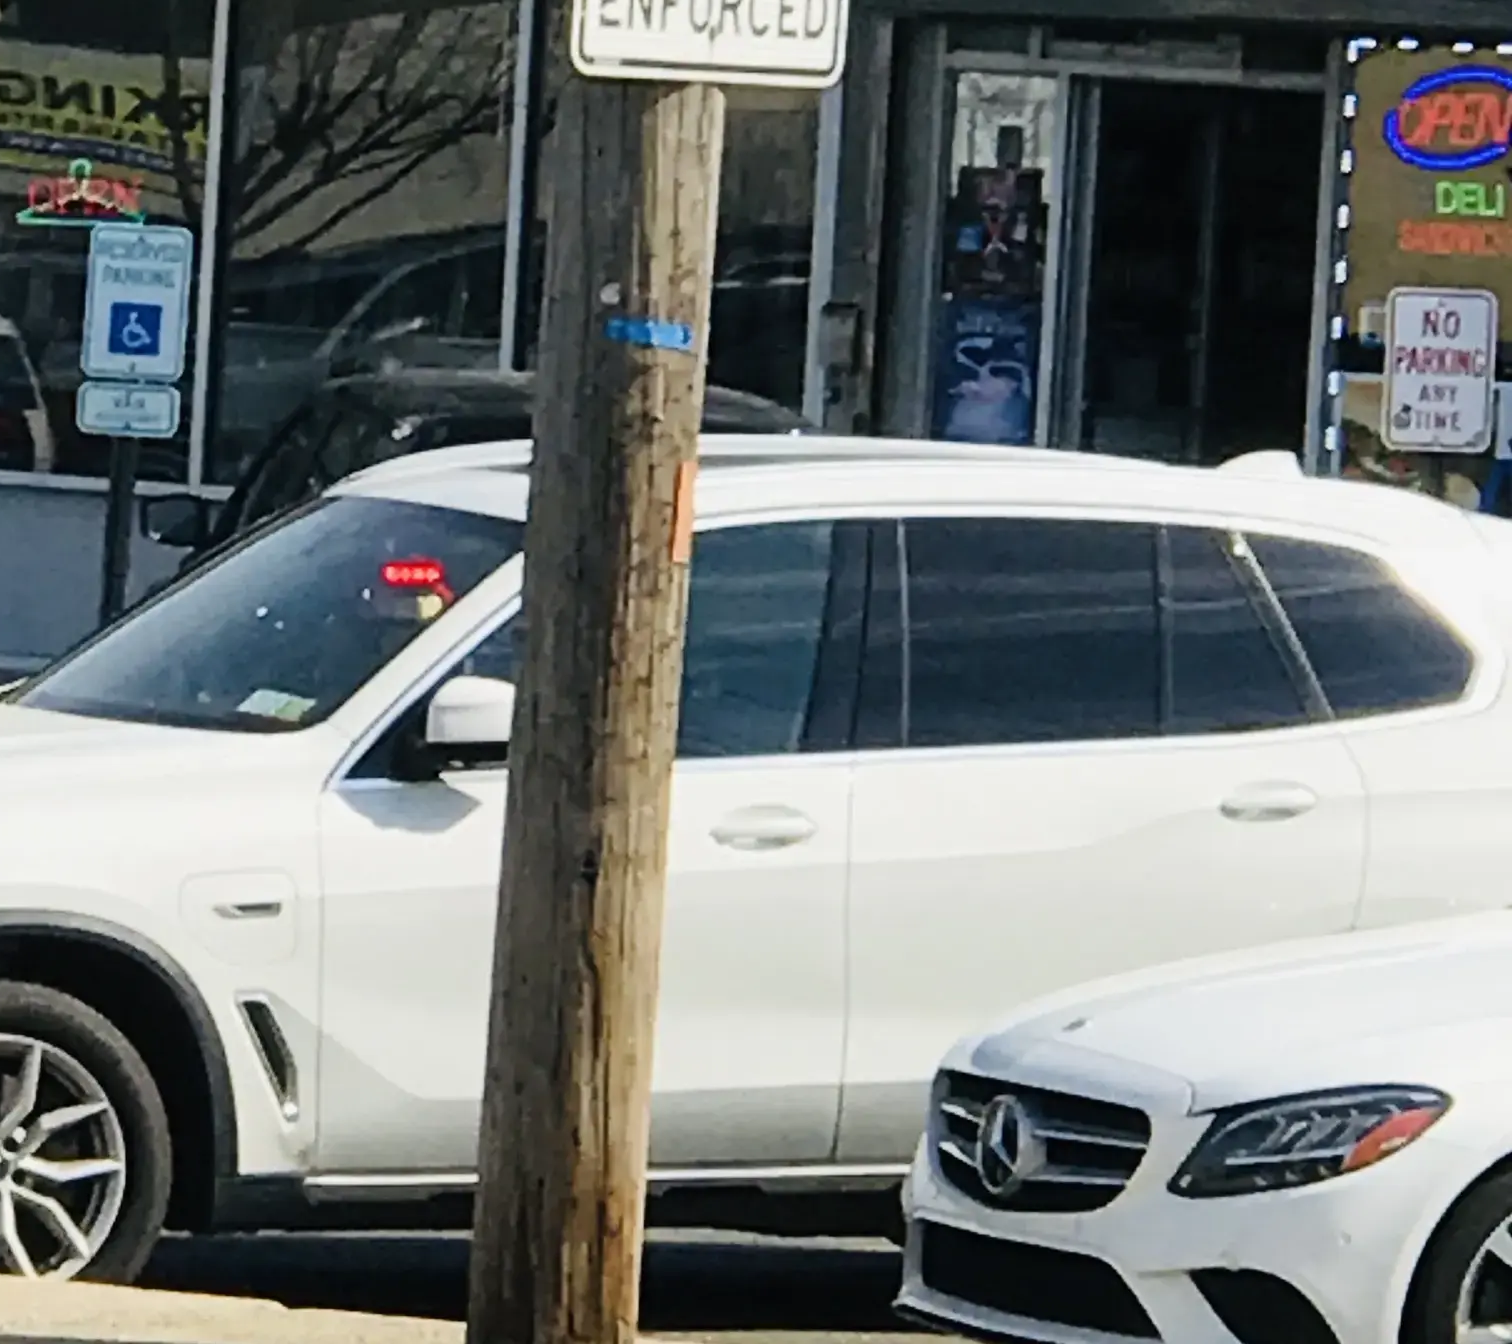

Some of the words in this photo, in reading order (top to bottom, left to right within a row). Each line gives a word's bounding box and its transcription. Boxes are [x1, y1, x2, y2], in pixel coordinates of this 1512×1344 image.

[1398, 92, 1512, 146] OPEN
[1435, 180, 1505, 218] DELI
[1420, 309, 1462, 340] NO
[1394, 346, 1488, 379] PARKING
[1418, 383, 1459, 405] ANY
[1413, 409, 1462, 433] TIME
